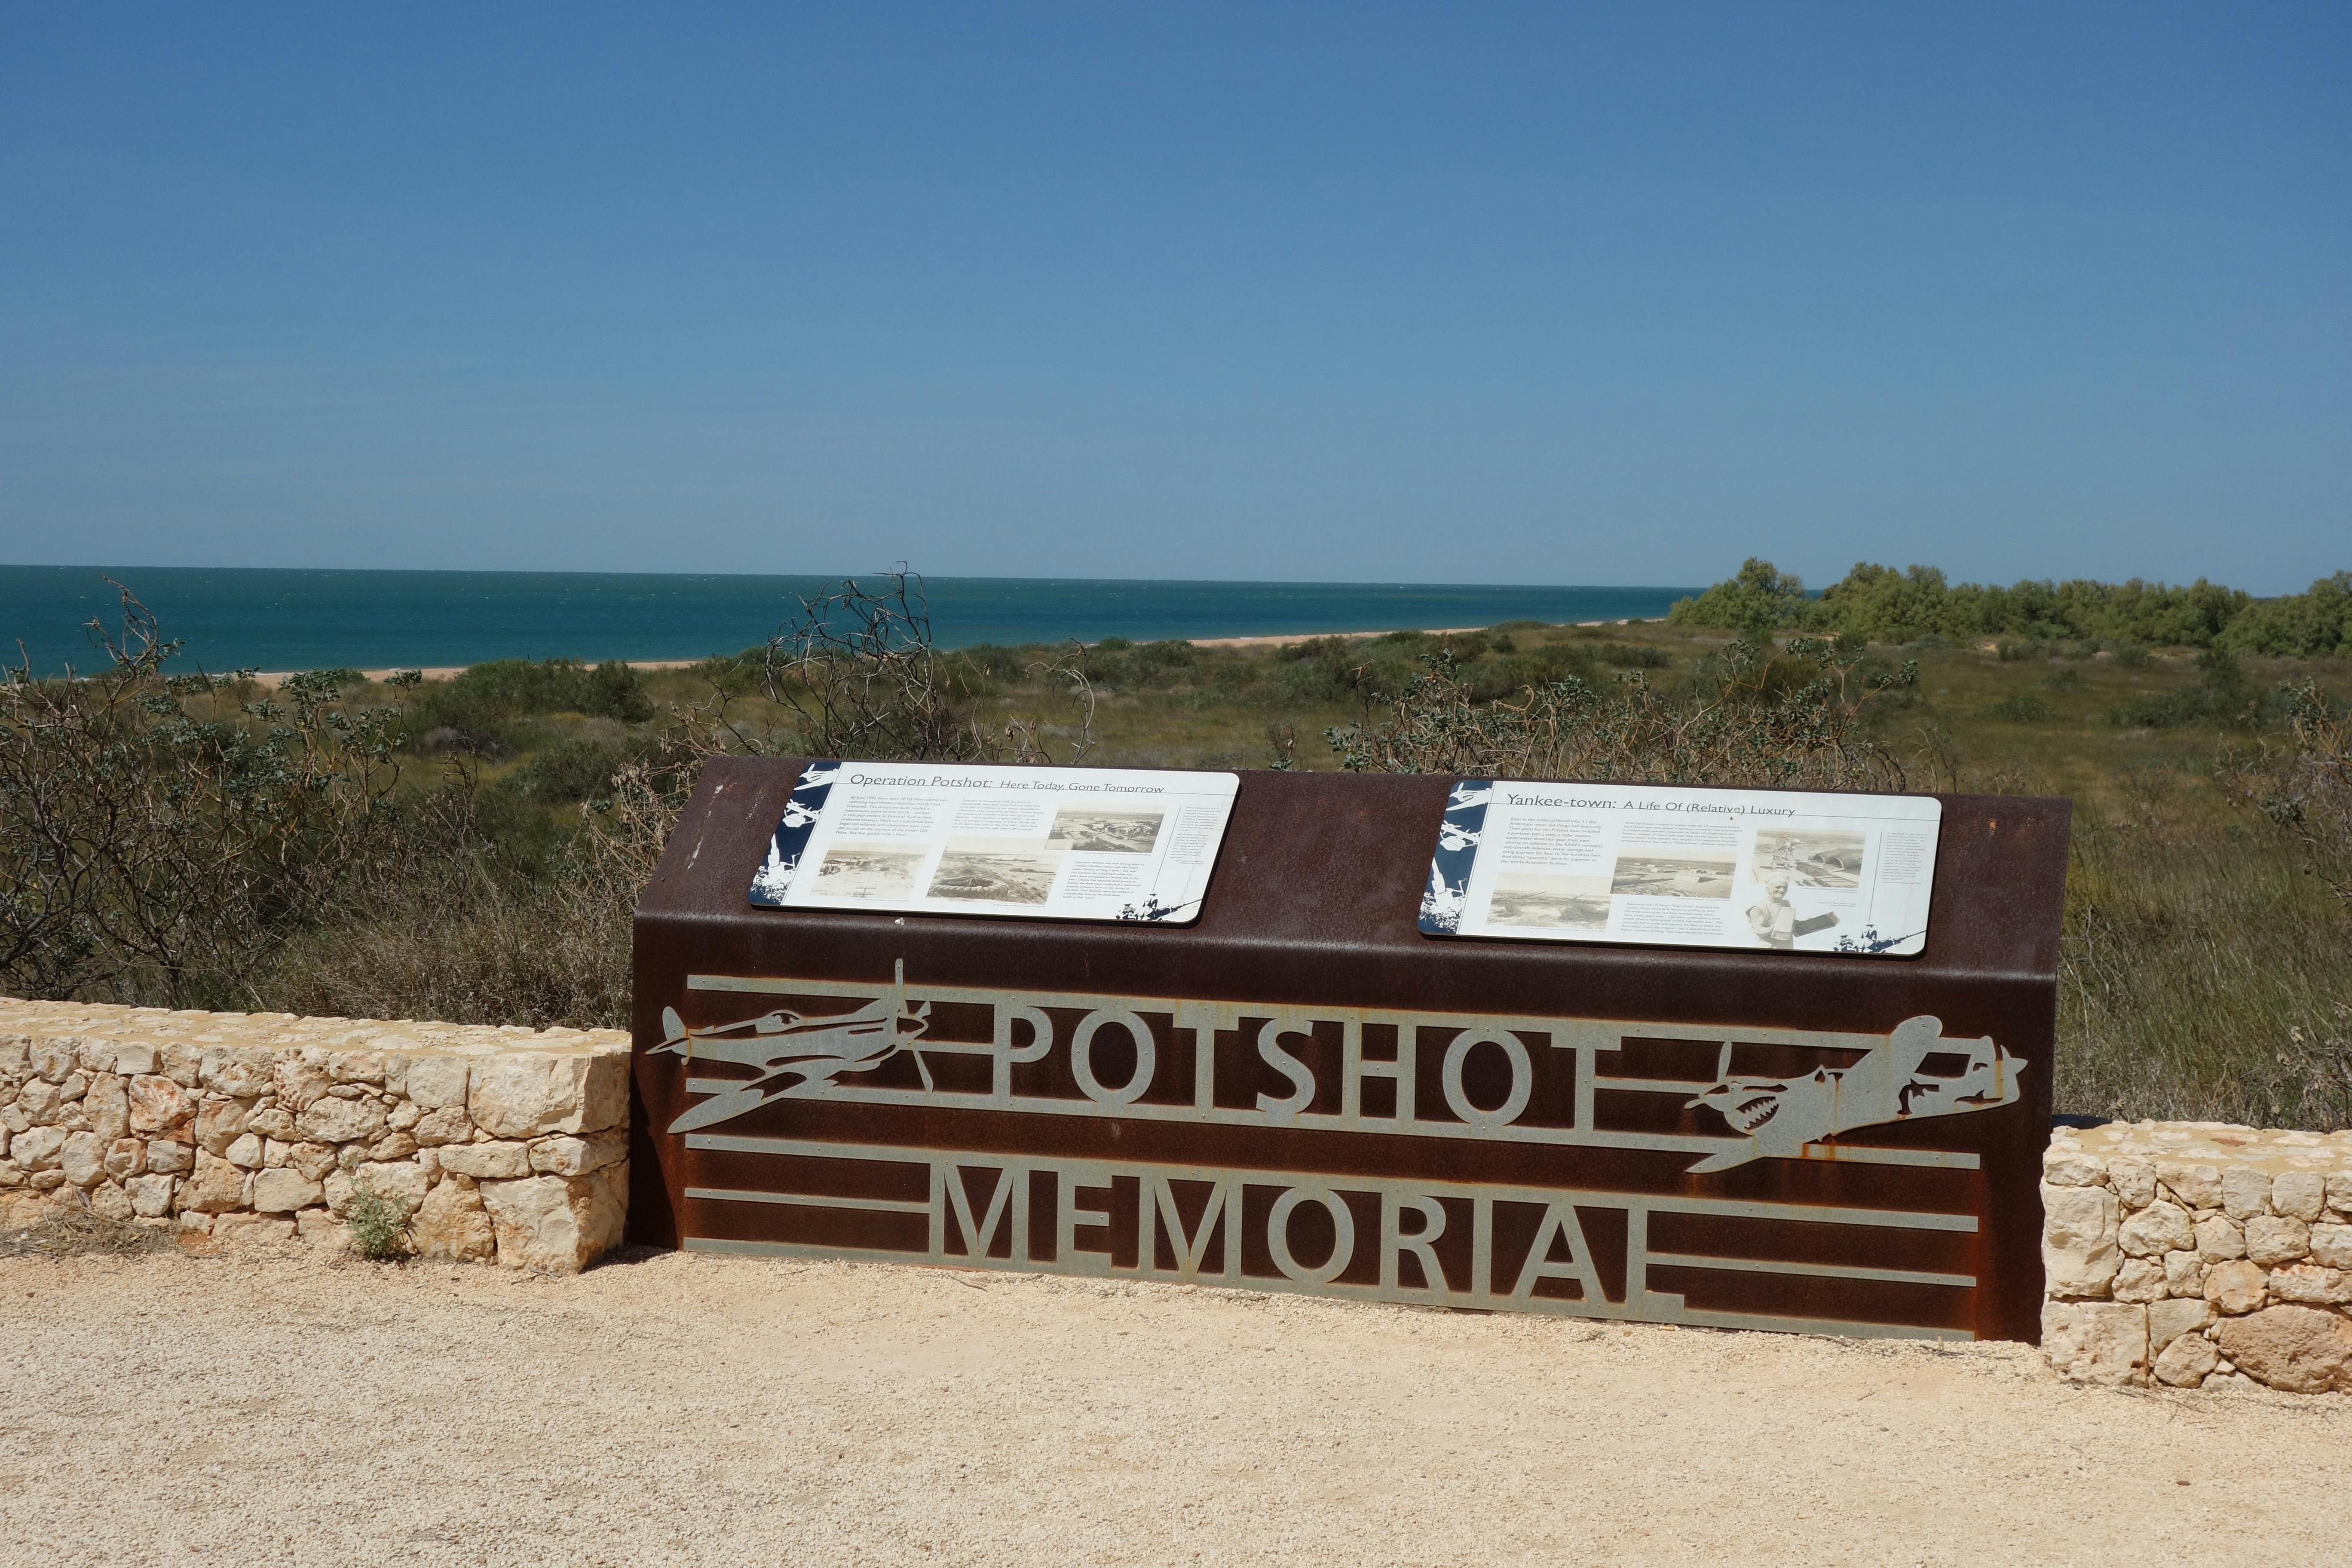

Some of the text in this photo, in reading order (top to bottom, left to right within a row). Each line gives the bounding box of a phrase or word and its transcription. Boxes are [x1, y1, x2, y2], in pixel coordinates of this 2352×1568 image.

[850, 774, 925, 787] Operation
[931, 776, 993, 788] Potshot:
[1000, 781, 1029, 789] Here
[1069, 783, 1100, 791] Gone
[1103, 783, 1164, 793] Tomorrow
[1507, 794, 1796, 818] Yankee-town: A Life Of (Relative) Luxury
[993, 992, 1621, 1138] POTSHOT
[929, 1154, 1684, 1323] MEMORIAL
